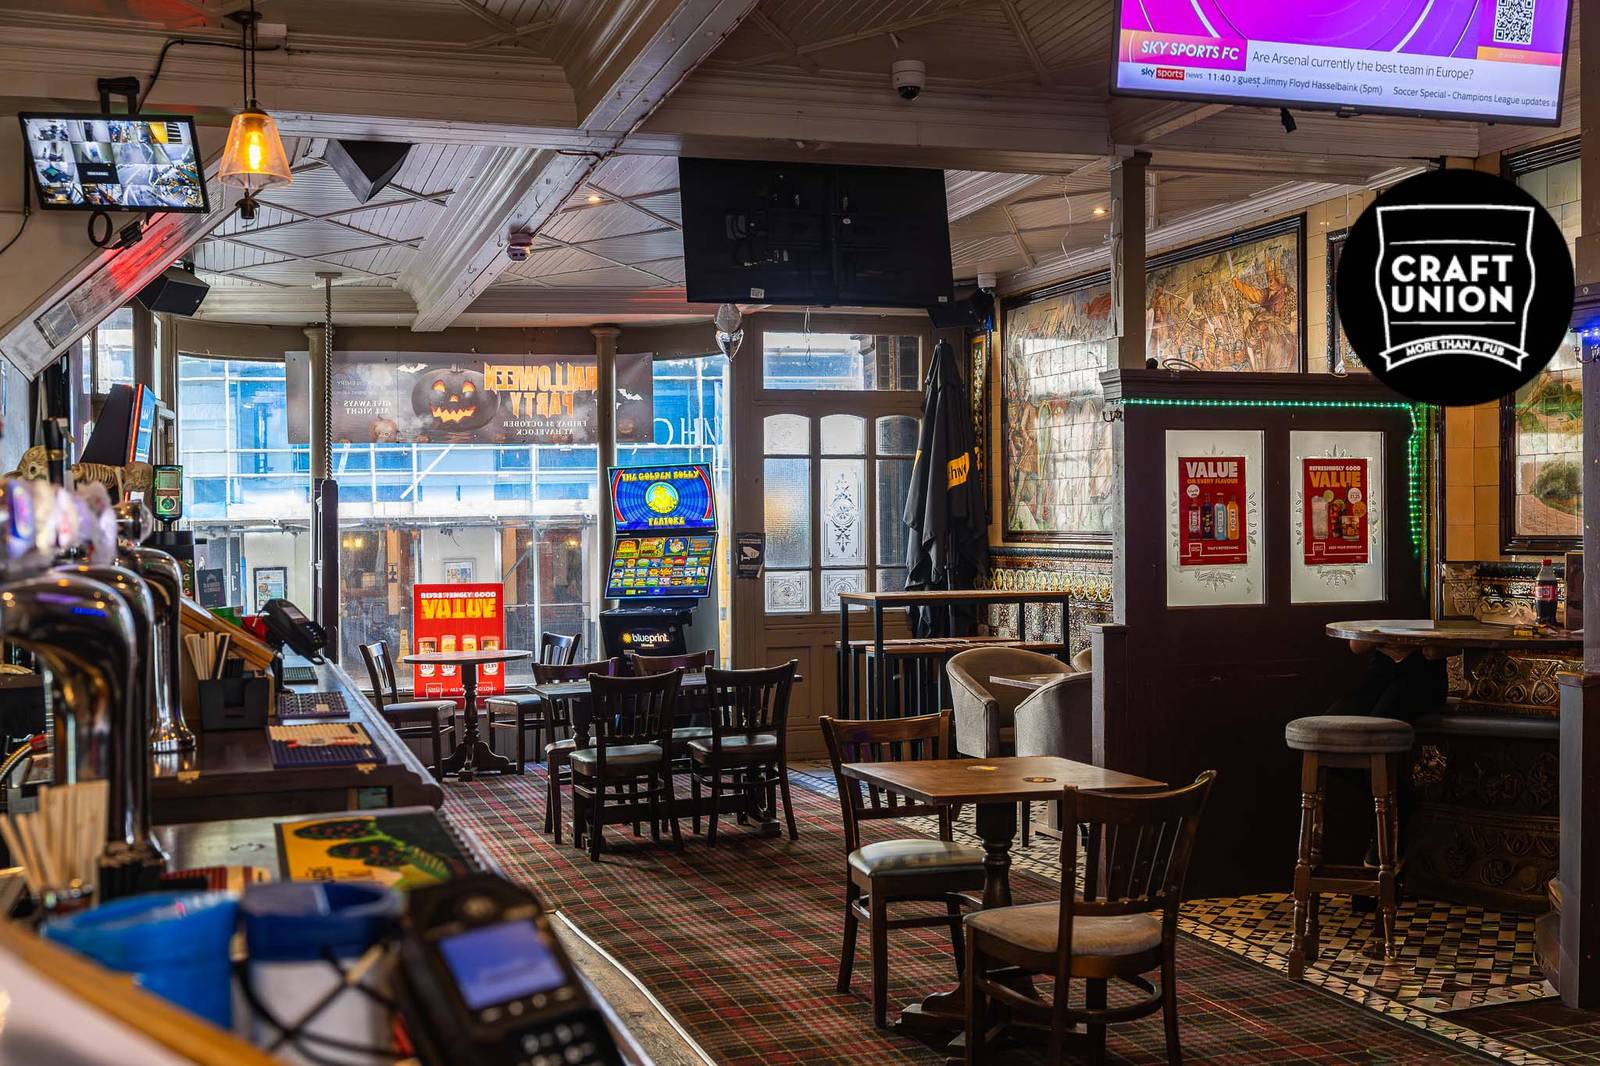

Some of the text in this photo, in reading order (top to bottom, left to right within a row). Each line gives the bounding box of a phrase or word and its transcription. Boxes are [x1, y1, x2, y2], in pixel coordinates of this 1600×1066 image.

[1141, 40, 1240, 60] SKY SPORTS FC
[1141, 66, 1203, 79] sky sports news
[1252, 51, 1474, 80] Are Arsenal currently the best team in Europe?
[1207, 73, 1231, 82] 11:40
[1238, 76, 1261, 86] guest
[1262, 76, 1287, 88] Jimmy
[1288, 78, 1310, 90] Floyd
[1311, 80, 1358, 92] Hasselbaink
[1359, 83, 1383, 96] (5pm)
[1393, 86, 1418, 97] Soccer
[1420, 87, 1447, 99] Special
[1452, 91, 1492, 103] Champions
[1494, 94, 1520, 106] League
[1521, 97, 1550, 107] updates
[1186, 461, 1238, 478] VALUE
[1309, 471, 1361, 488] VALUE
[420, 598, 496, 619] VALUE
[632, 633, 669, 643] blueprint
